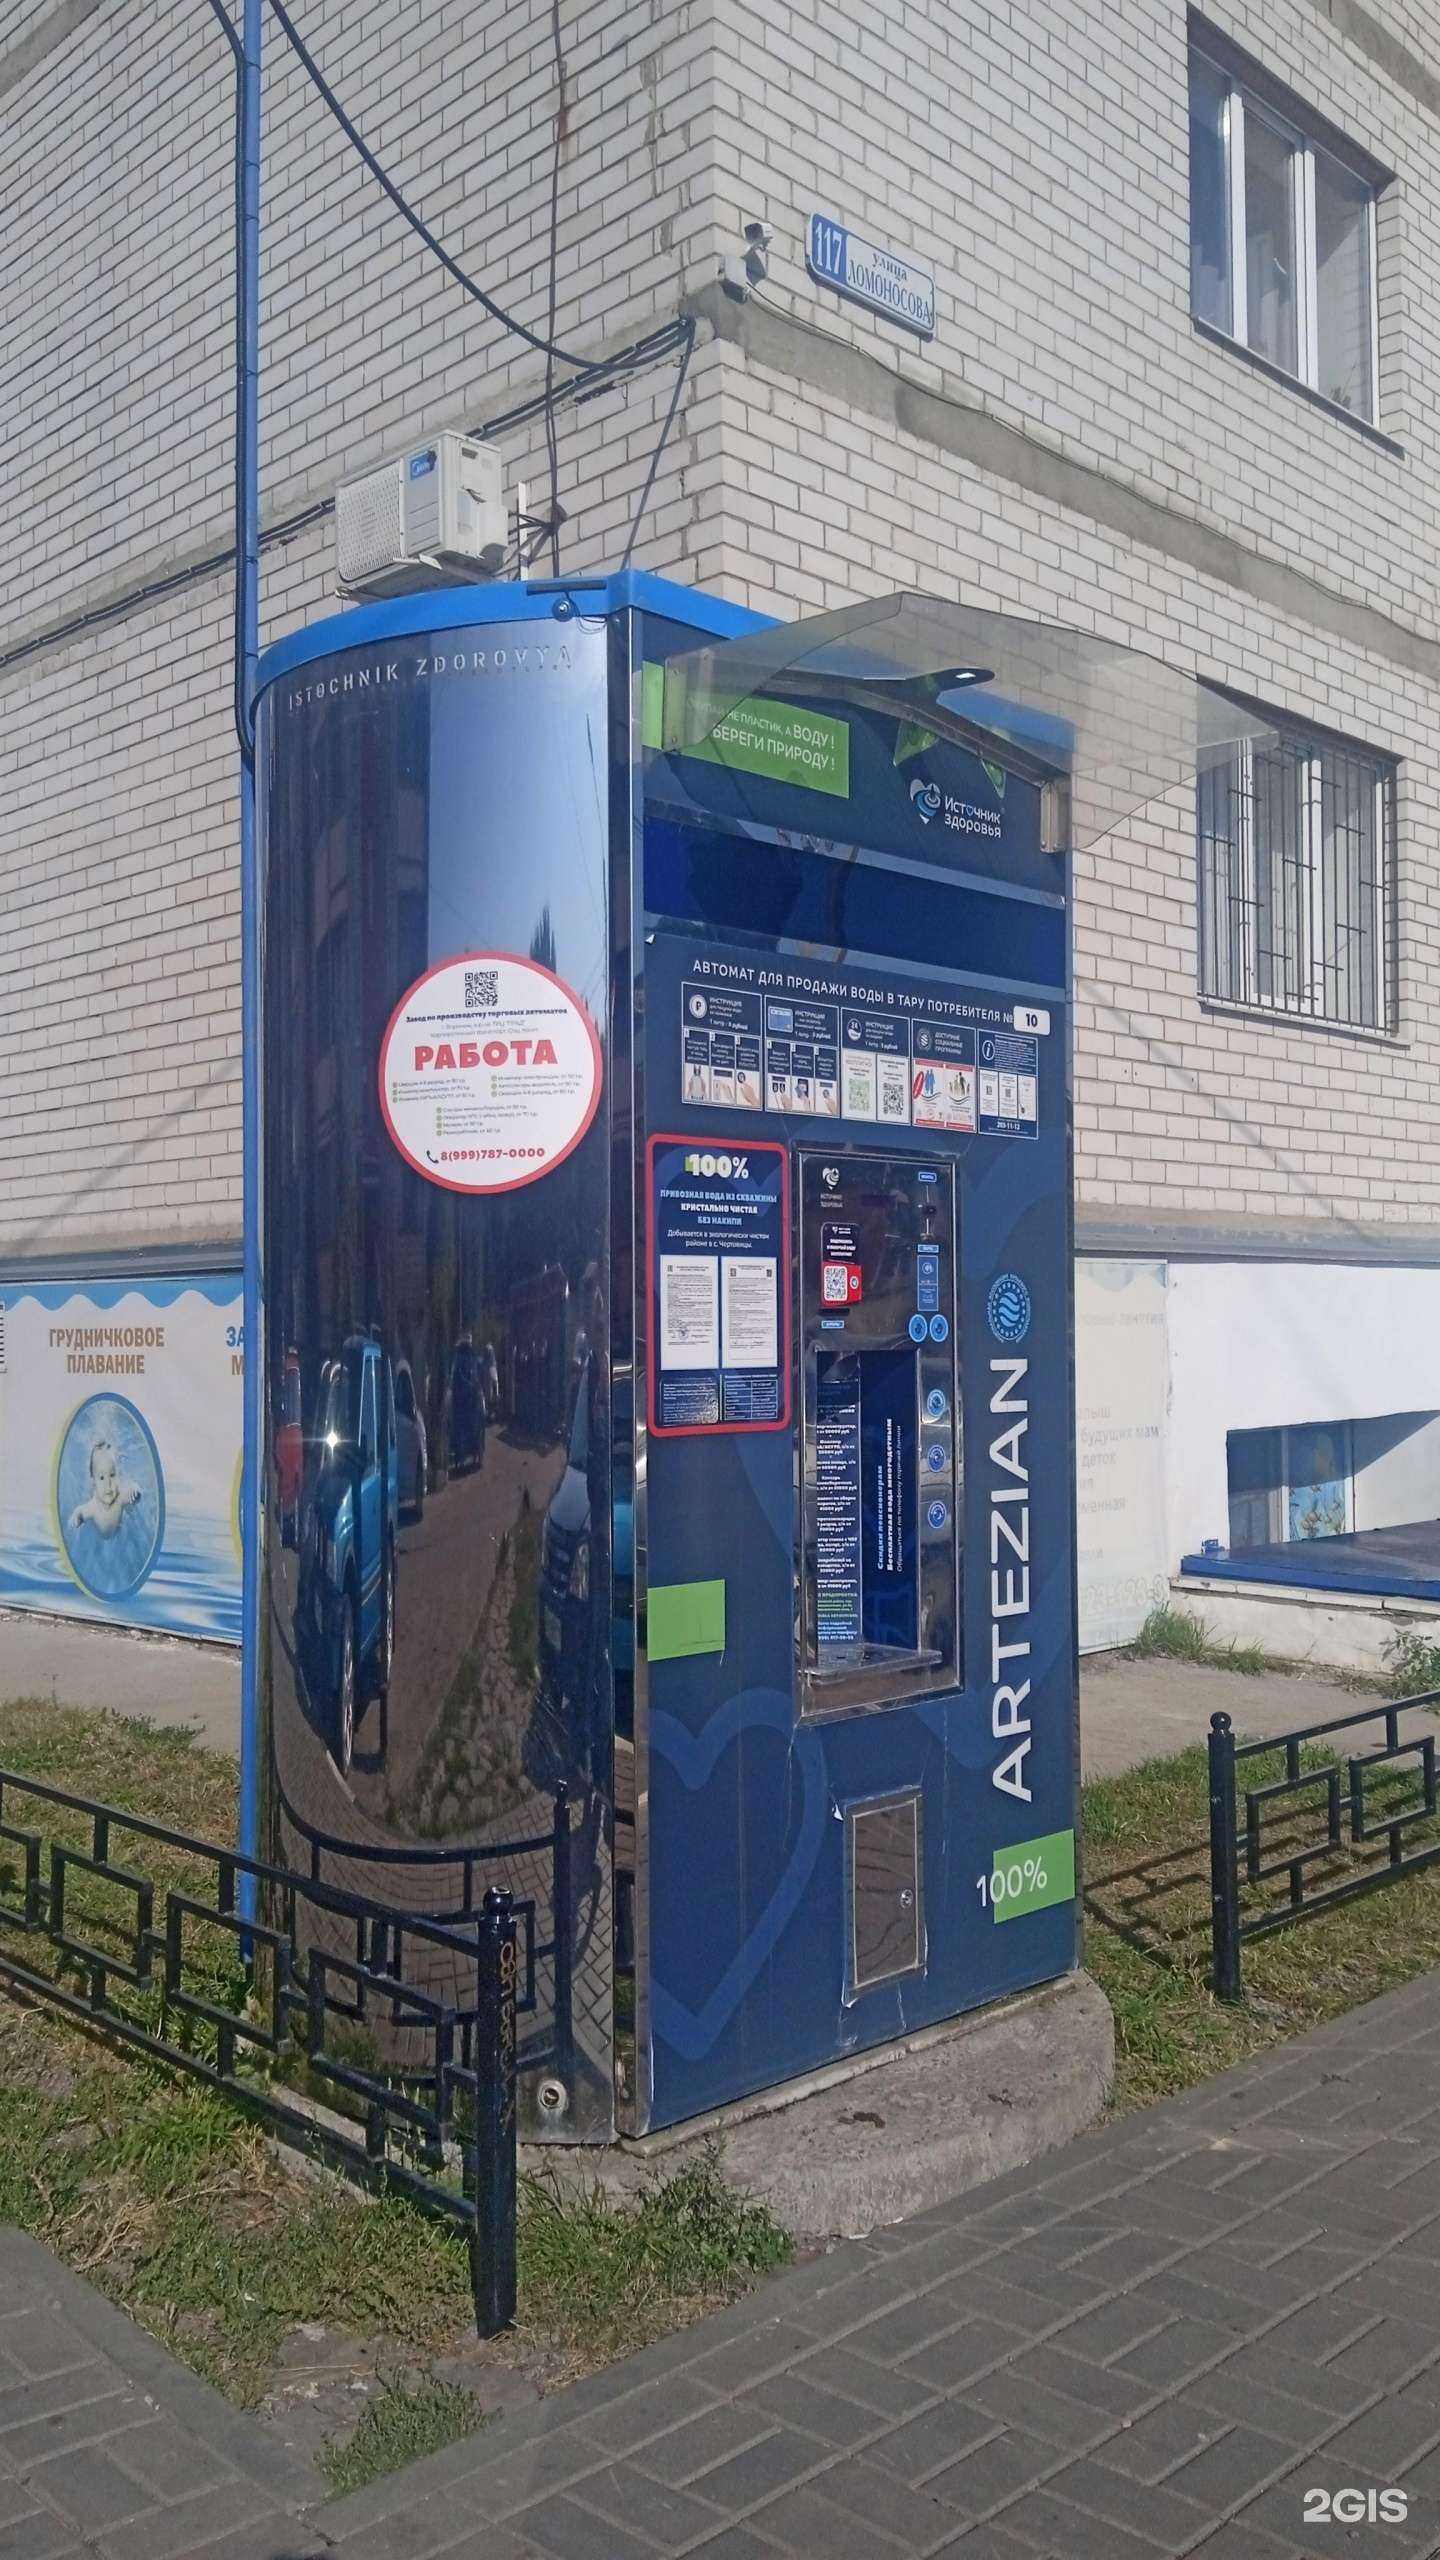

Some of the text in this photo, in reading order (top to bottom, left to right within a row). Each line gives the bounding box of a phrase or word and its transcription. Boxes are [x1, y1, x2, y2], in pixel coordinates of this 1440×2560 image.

[815, 222, 842, 274] 117
[848, 260, 932, 324] ЛОМОНОСОВА
[289, 645, 573, 711] ISTOCHNIK ZDOROVYA
[712, 725, 764, 751] БЕРЕГИ
[767, 738, 829, 770] ПРИРОДУ
[793, 724, 828, 748] ВОДУ
[693, 960, 754, 981] АВТОМАТ
[759, 971, 783, 987] ДЛЯ
[787, 976, 847, 996] ПРОДАЖИ
[851, 986, 884, 1004] ВОДЫ
[887, 992, 894, 1004] В
[897, 995, 925, 1009] ТАРУ
[927, 1000, 1001, 1021] ПОТРЕБИТЕЛЯ
[1025, 1013, 1038, 1028] 10
[414, 1039, 558, 1071] РАБОТА
[440, 1148, 545, 1161] 8(999)787-0000
[688, 1154, 749, 1179] 100%
[660, 1189, 704, 1199] ПРИВОЗНАЯ
[705, 1191, 726, 1201] ВОДА
[681, 1203, 758, 1214] КРИСТАЛЬНО ЧИСТАЯ
[49, 1327, 165, 1351] ГРУДНИЧКОВОЕ
[66, 1354, 145, 1374] ПЛАВАНИЕ
[989, 1358, 1032, 1803] ARTEZIAN
[976, 1855, 1048, 1908] 100%
